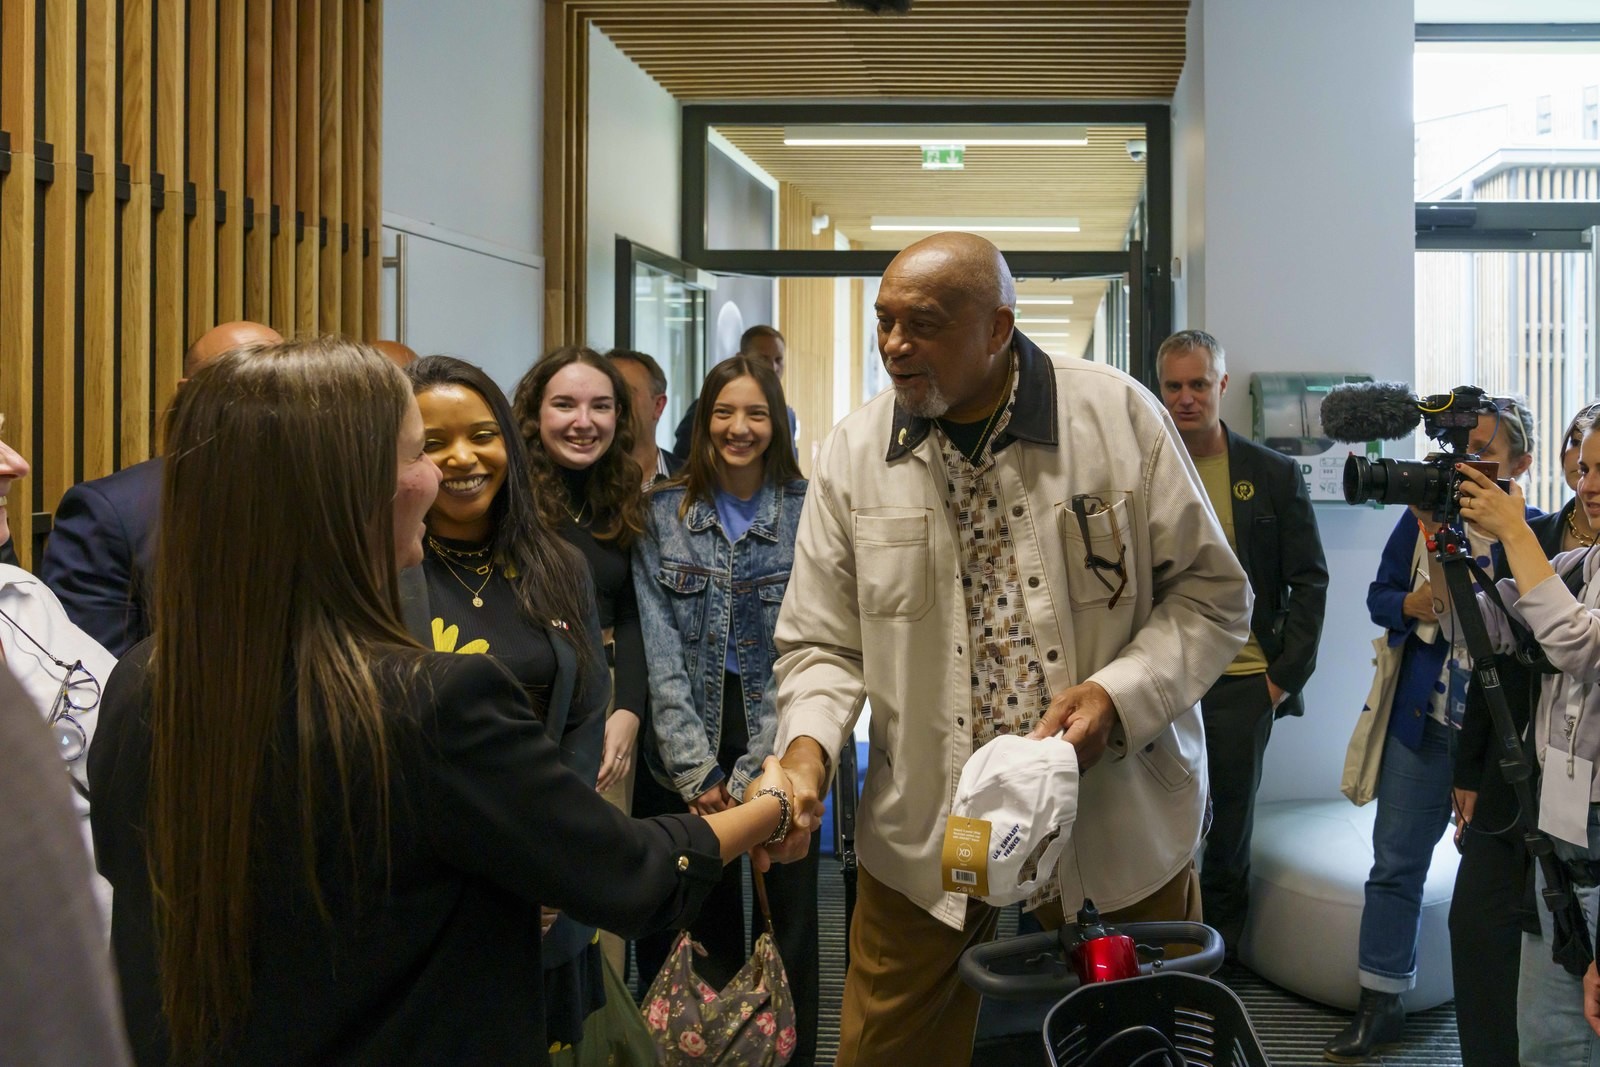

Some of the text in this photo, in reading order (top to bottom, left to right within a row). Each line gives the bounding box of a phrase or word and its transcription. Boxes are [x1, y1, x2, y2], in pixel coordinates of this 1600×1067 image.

[992, 824, 1020, 859] U.S. EMBASSY
[1003, 836, 1020, 857] FRANCE
